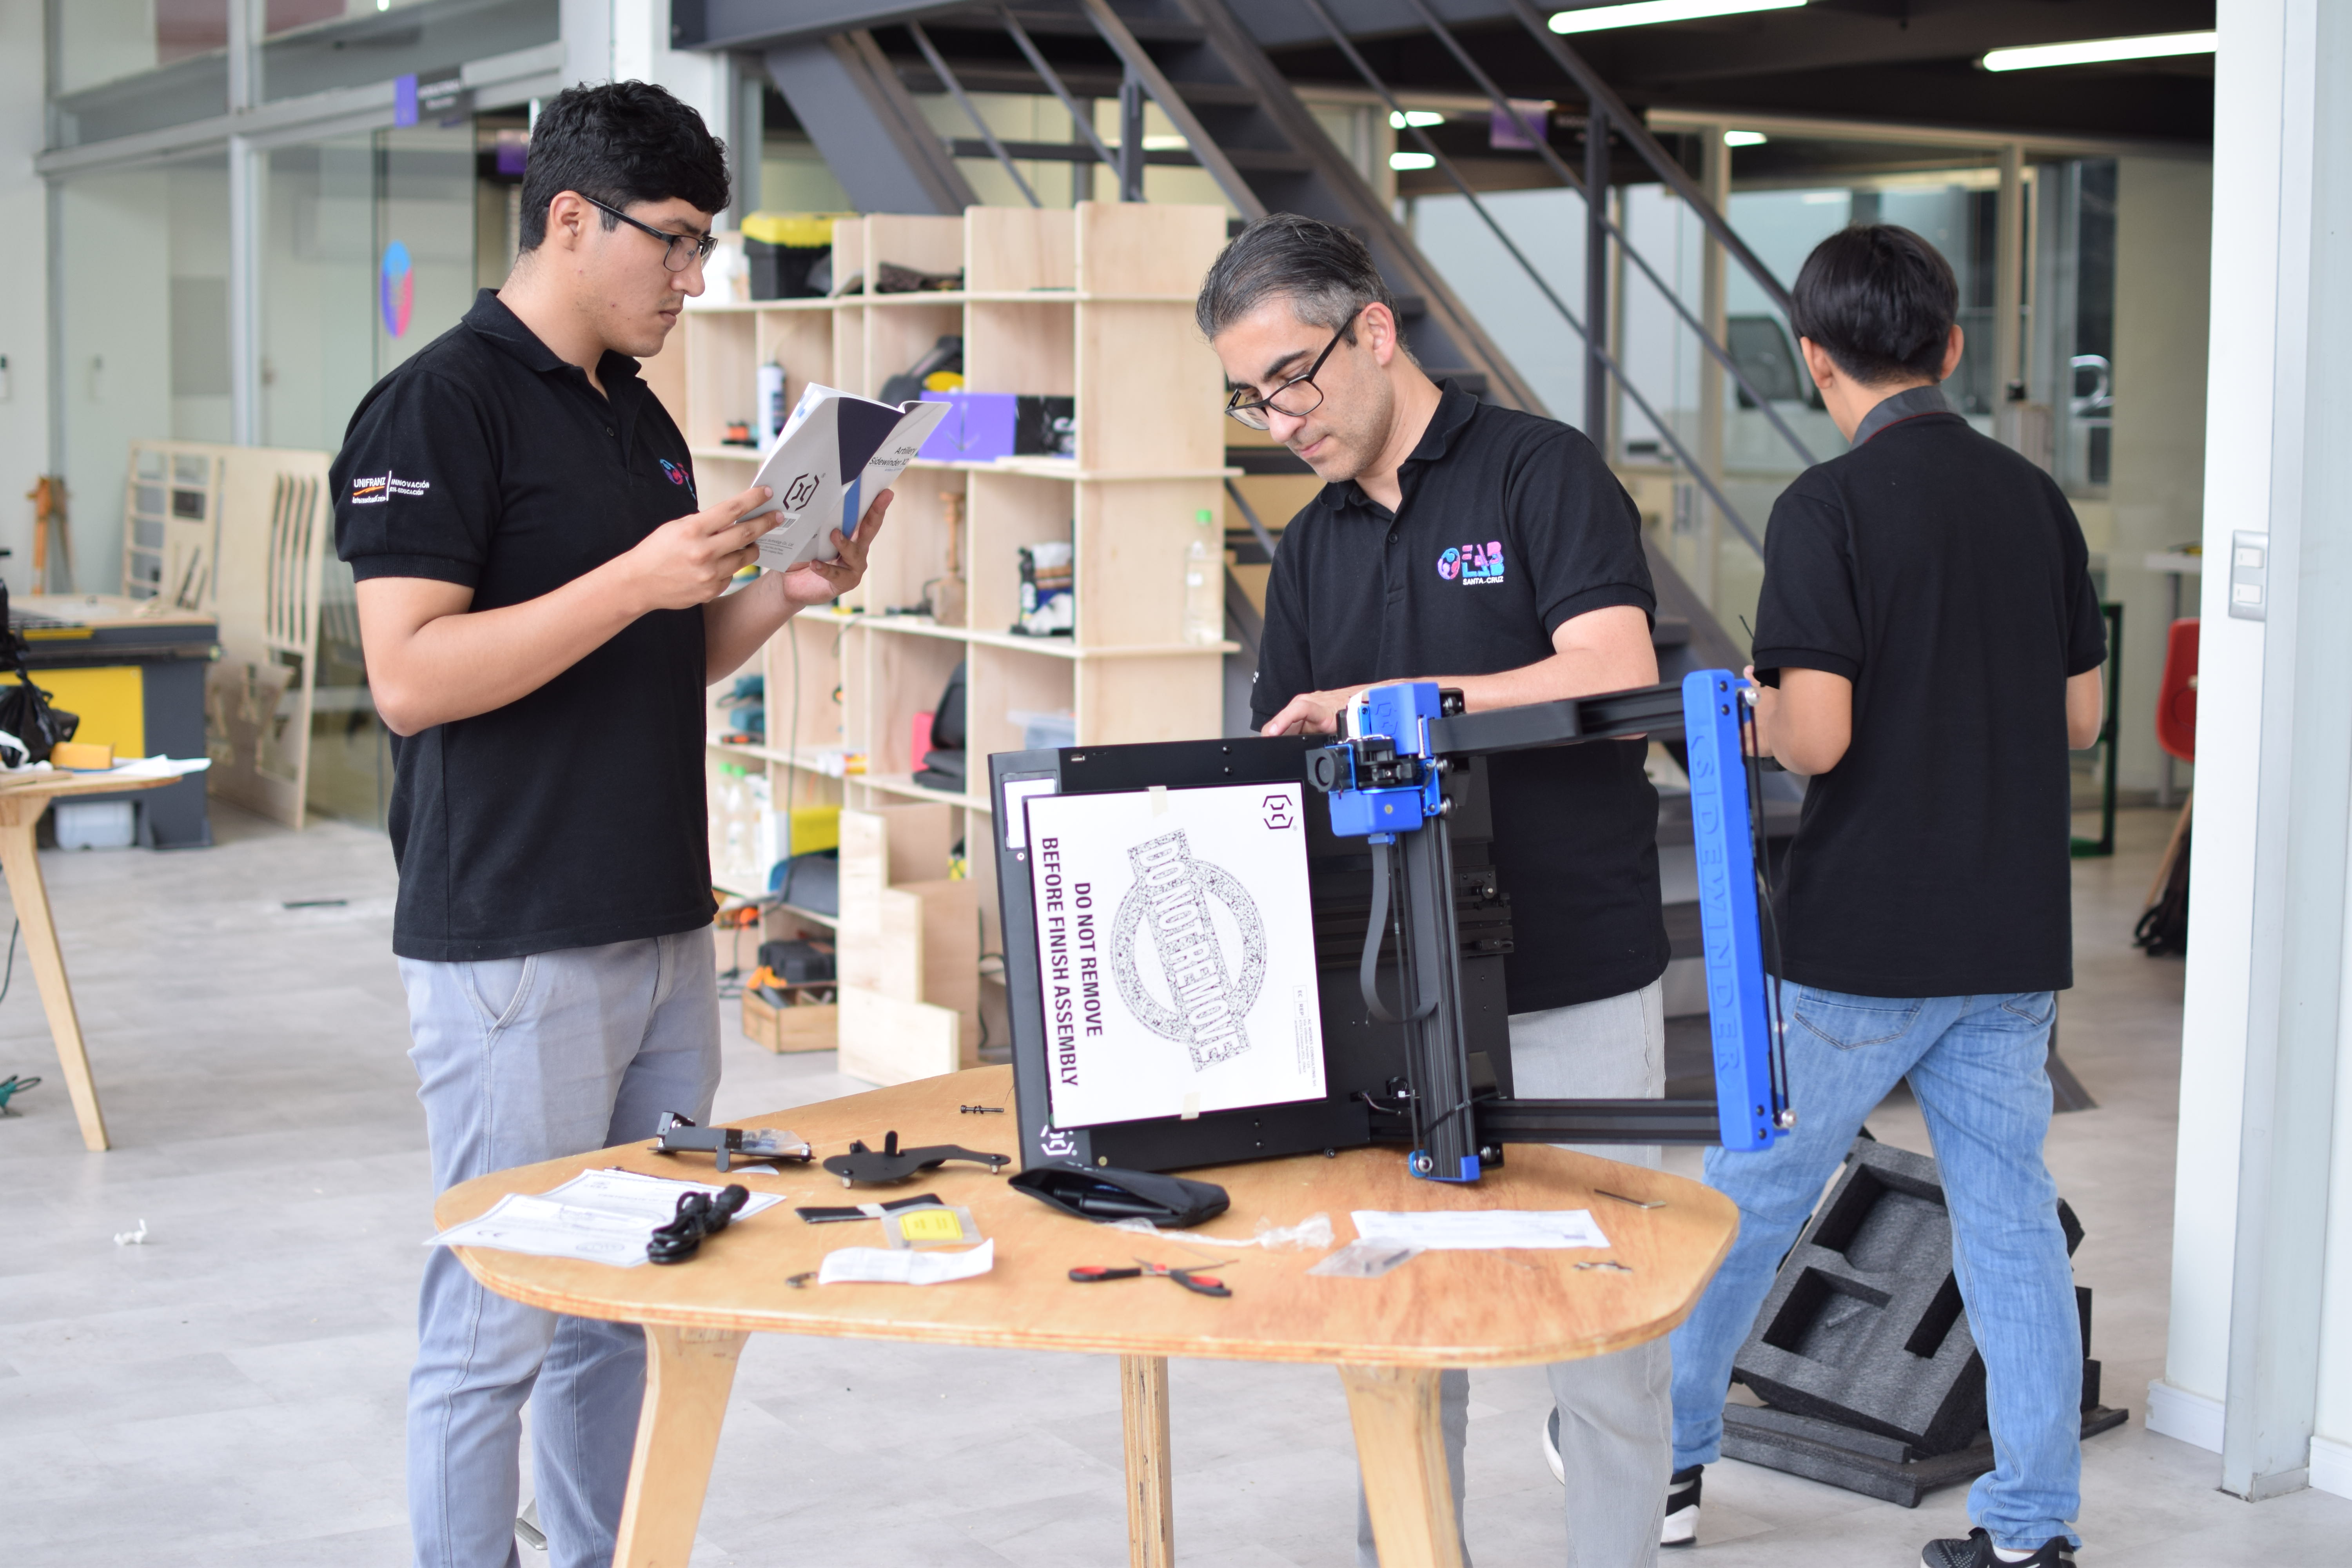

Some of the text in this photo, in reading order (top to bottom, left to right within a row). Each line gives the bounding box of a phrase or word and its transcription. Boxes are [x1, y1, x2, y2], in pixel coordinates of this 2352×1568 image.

[894, 446, 917, 456] Artillery
[869, 457, 902, 466] Sidewinder
[354, 477, 386, 487] UNIFRANZ
[391, 479, 430, 488] INNOVACIÓN
[1486, 575, 1504, 584] CRUZ
[1693, 753, 1741, 1074] SIDEWINDER
[1138, 839, 1241, 1063] DO NOT REMOVE
[1042, 837, 1078, 1086] BEFORE FINISH ASSEMBLY
[1074, 882, 1103, 1037] DO NOT REMOVE
[1298, 990, 1303, 998] EC
